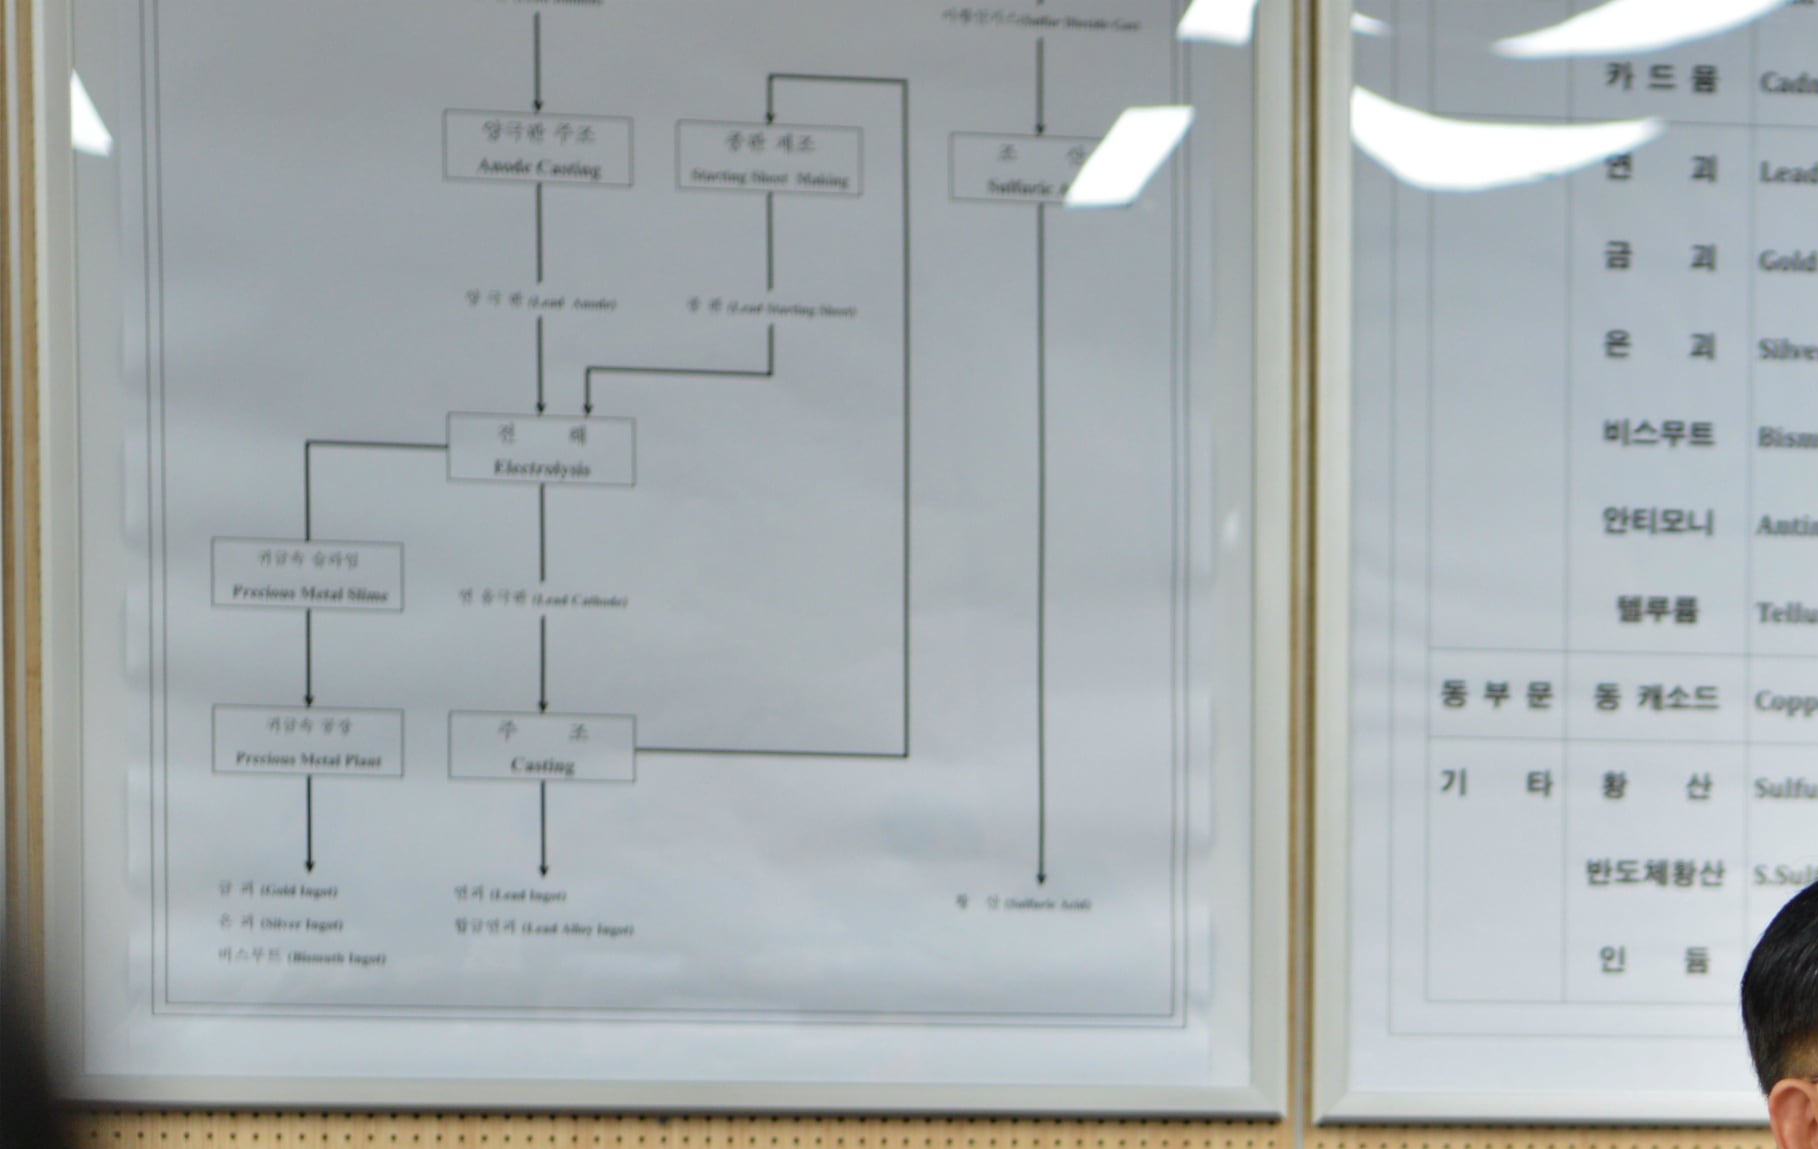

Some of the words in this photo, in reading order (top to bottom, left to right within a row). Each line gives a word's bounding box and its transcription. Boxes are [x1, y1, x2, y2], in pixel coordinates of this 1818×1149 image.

[536, 160, 601, 182] Casting
[1758, 250, 1818, 273] Gold
[511, 758, 574, 776] Casting
